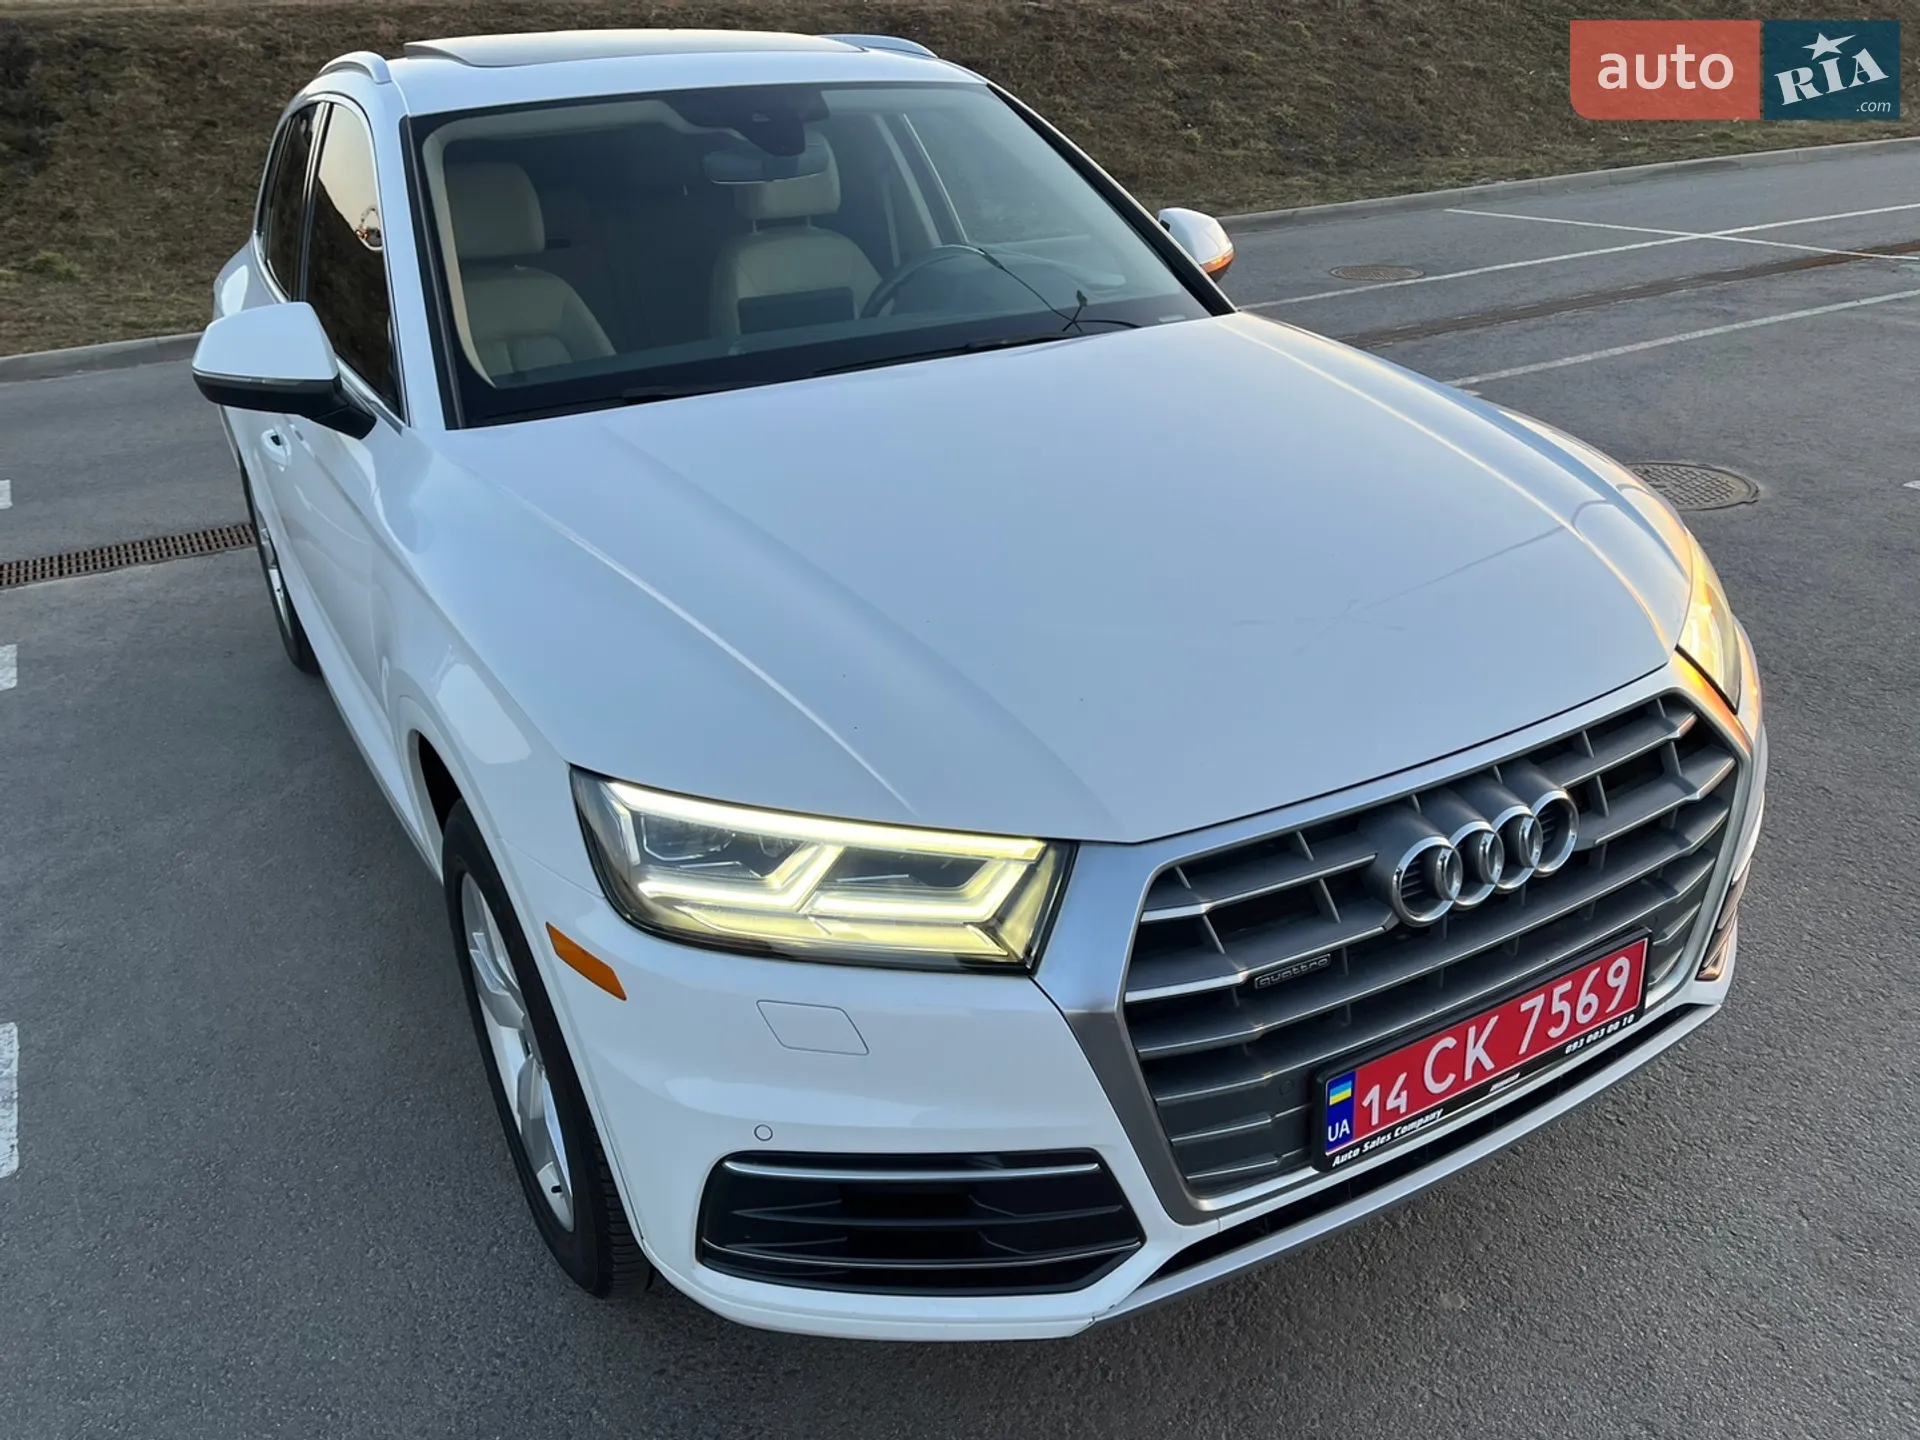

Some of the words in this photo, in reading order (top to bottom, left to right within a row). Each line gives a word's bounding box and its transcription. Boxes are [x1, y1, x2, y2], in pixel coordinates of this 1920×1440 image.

[1259, 957, 1328, 986] quattro
[1361, 1072, 1408, 1126] 14
[1423, 1015, 1499, 1095] CK
[1518, 956, 1631, 1055] 7569
[1328, 1118, 1350, 1142] UA
[1332, 1148, 1360, 1167] Auto
[1362, 1132, 1392, 1153] Sales
[1394, 1108, 1444, 1137] Company
